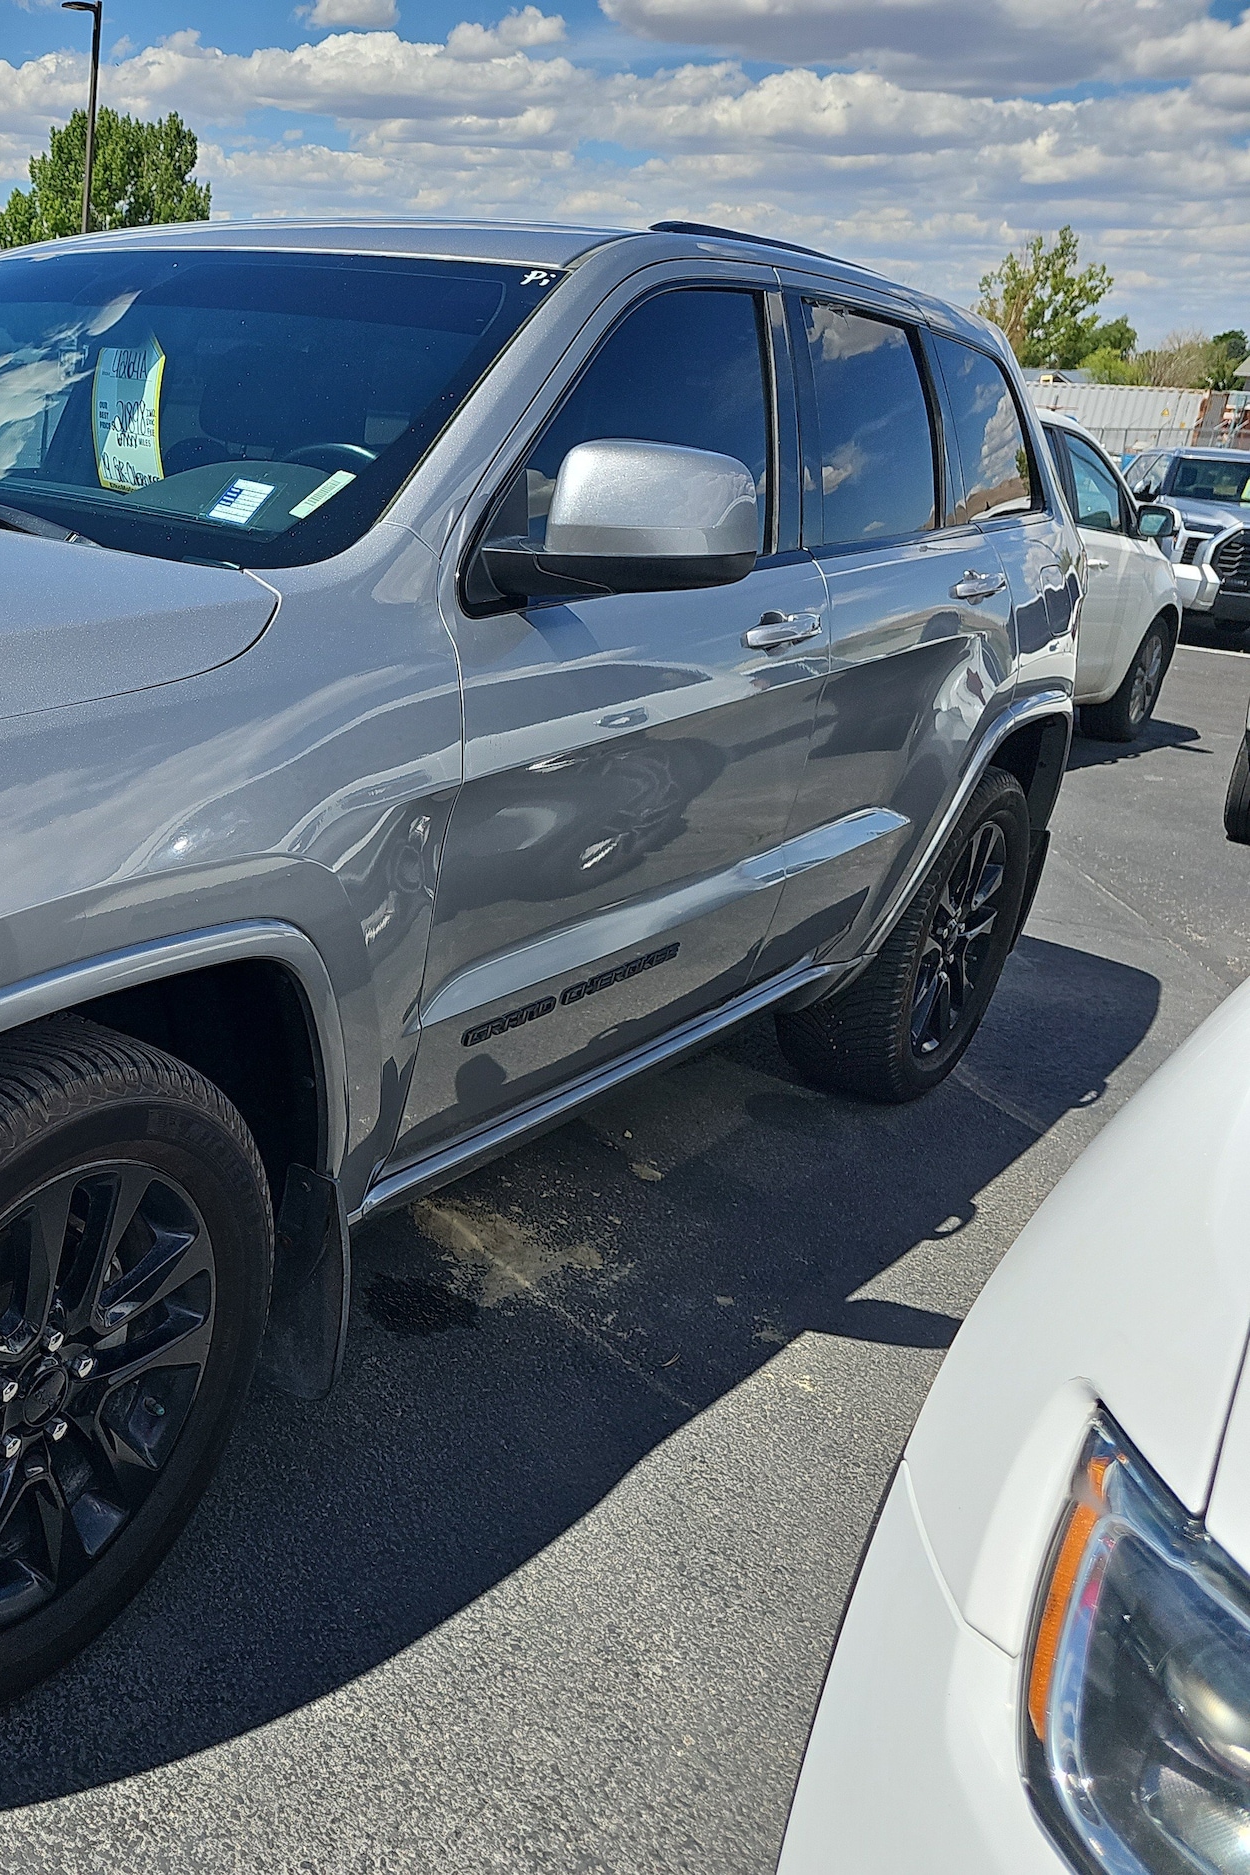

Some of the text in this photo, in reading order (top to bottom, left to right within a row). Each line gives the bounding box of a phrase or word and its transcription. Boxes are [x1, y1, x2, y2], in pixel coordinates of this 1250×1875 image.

[99, 401, 108, 409] OUR
[99, 411, 109, 420] BEST
[99, 421, 111, 430] PRICE
[460, 941, 681, 1047] GRAND CHEROKEE
